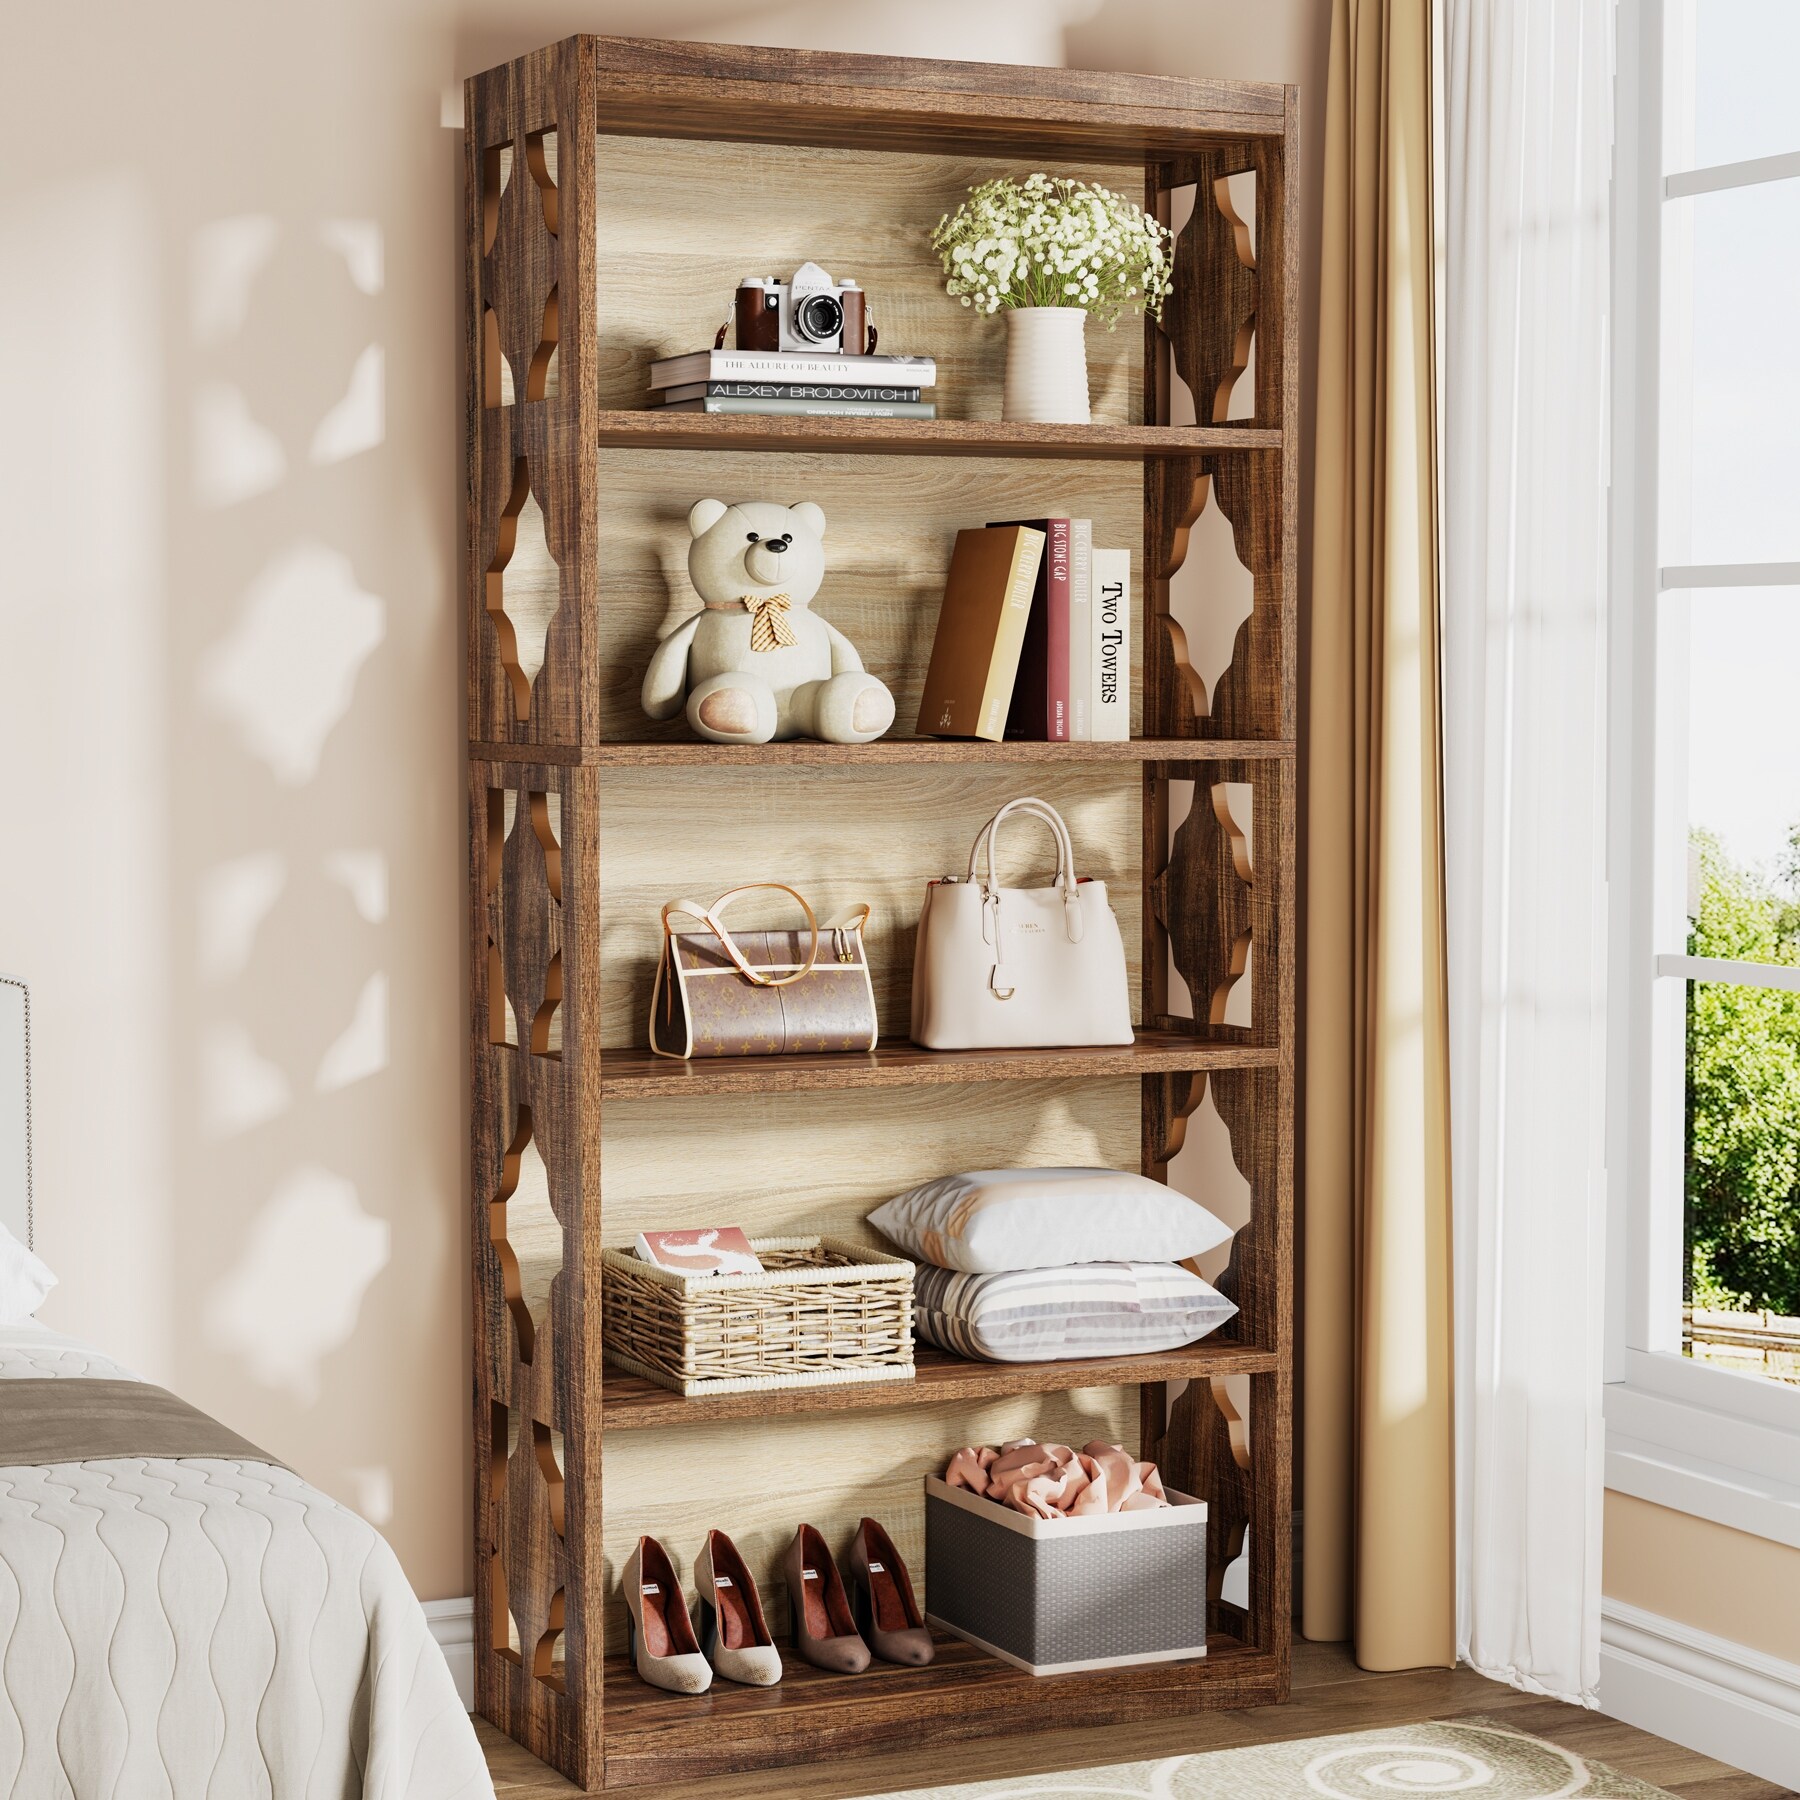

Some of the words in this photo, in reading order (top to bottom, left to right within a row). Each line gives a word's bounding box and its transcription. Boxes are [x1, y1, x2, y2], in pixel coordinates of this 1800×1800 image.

[750, 362, 789, 370] ALLURE
[808, 363, 849, 372] BEAUTY
[712, 384, 784, 397] ALEXEY
[790, 386, 907, 400] BRODOVITCH
[1053, 523, 1067, 538] BIG
[1074, 525, 1088, 539] BIG
[1023, 533, 1040, 549] BIG
[1053, 540, 1067, 563] STONE
[1053, 566, 1067, 582] GAP
